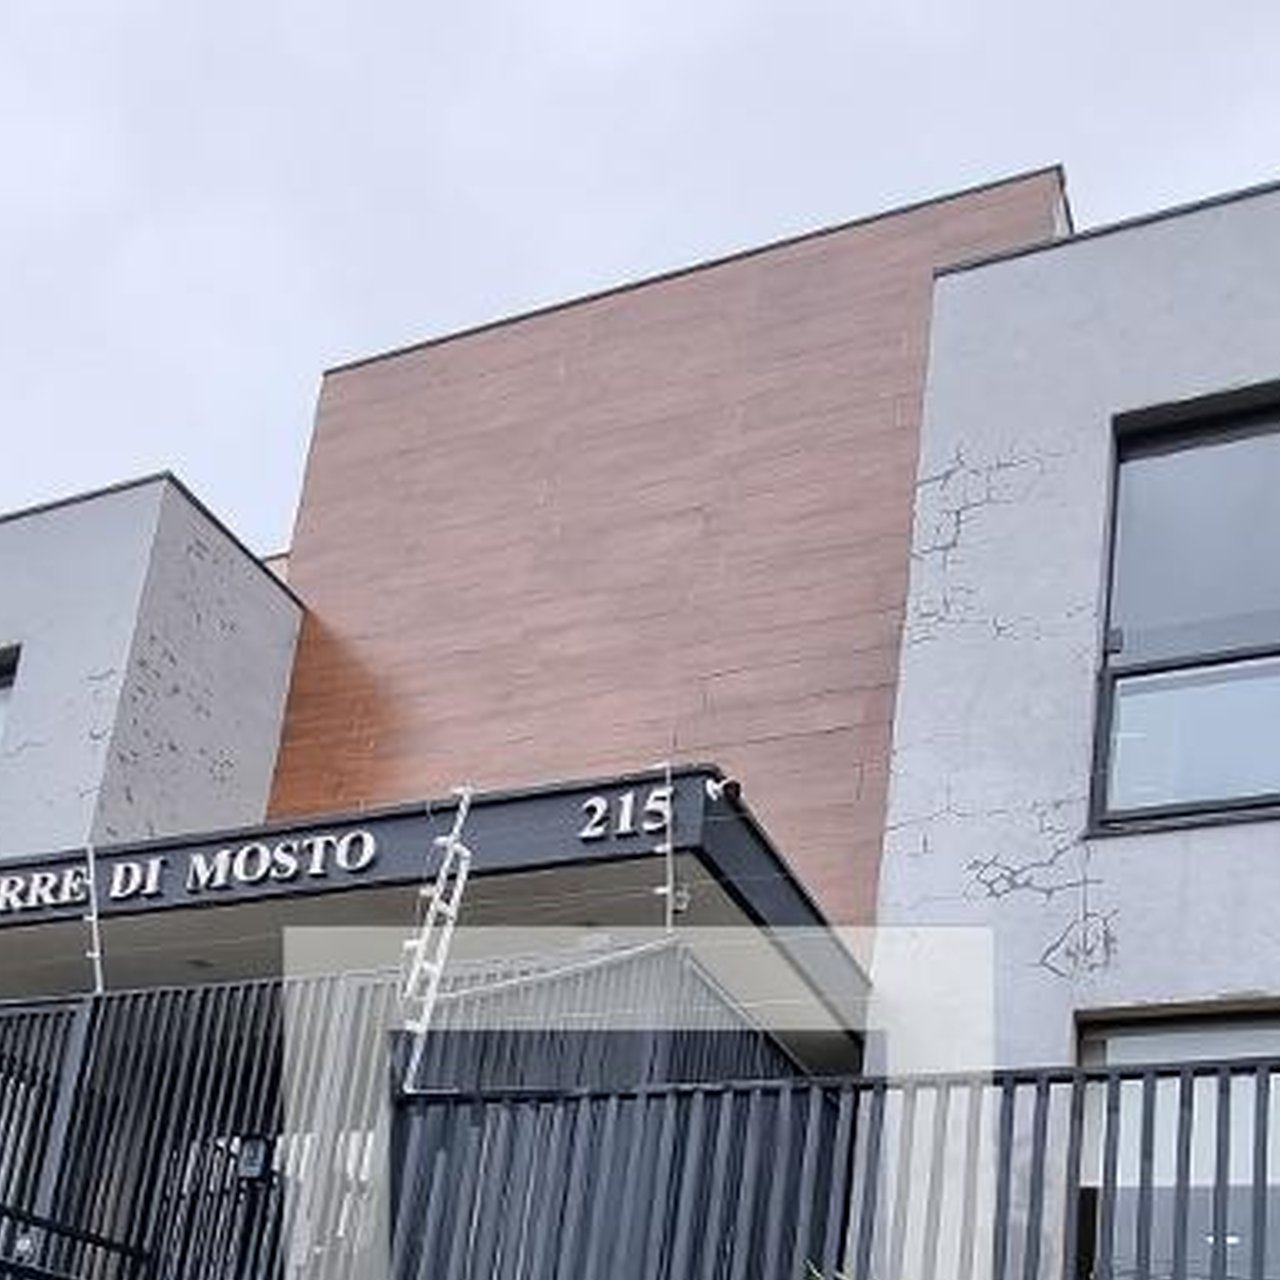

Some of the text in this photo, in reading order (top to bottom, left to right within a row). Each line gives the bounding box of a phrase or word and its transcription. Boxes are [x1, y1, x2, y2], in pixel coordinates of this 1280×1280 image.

[578, 787, 674, 839] 215
[109, 856, 165, 899] DI
[186, 829, 376, 890] MOSTO
